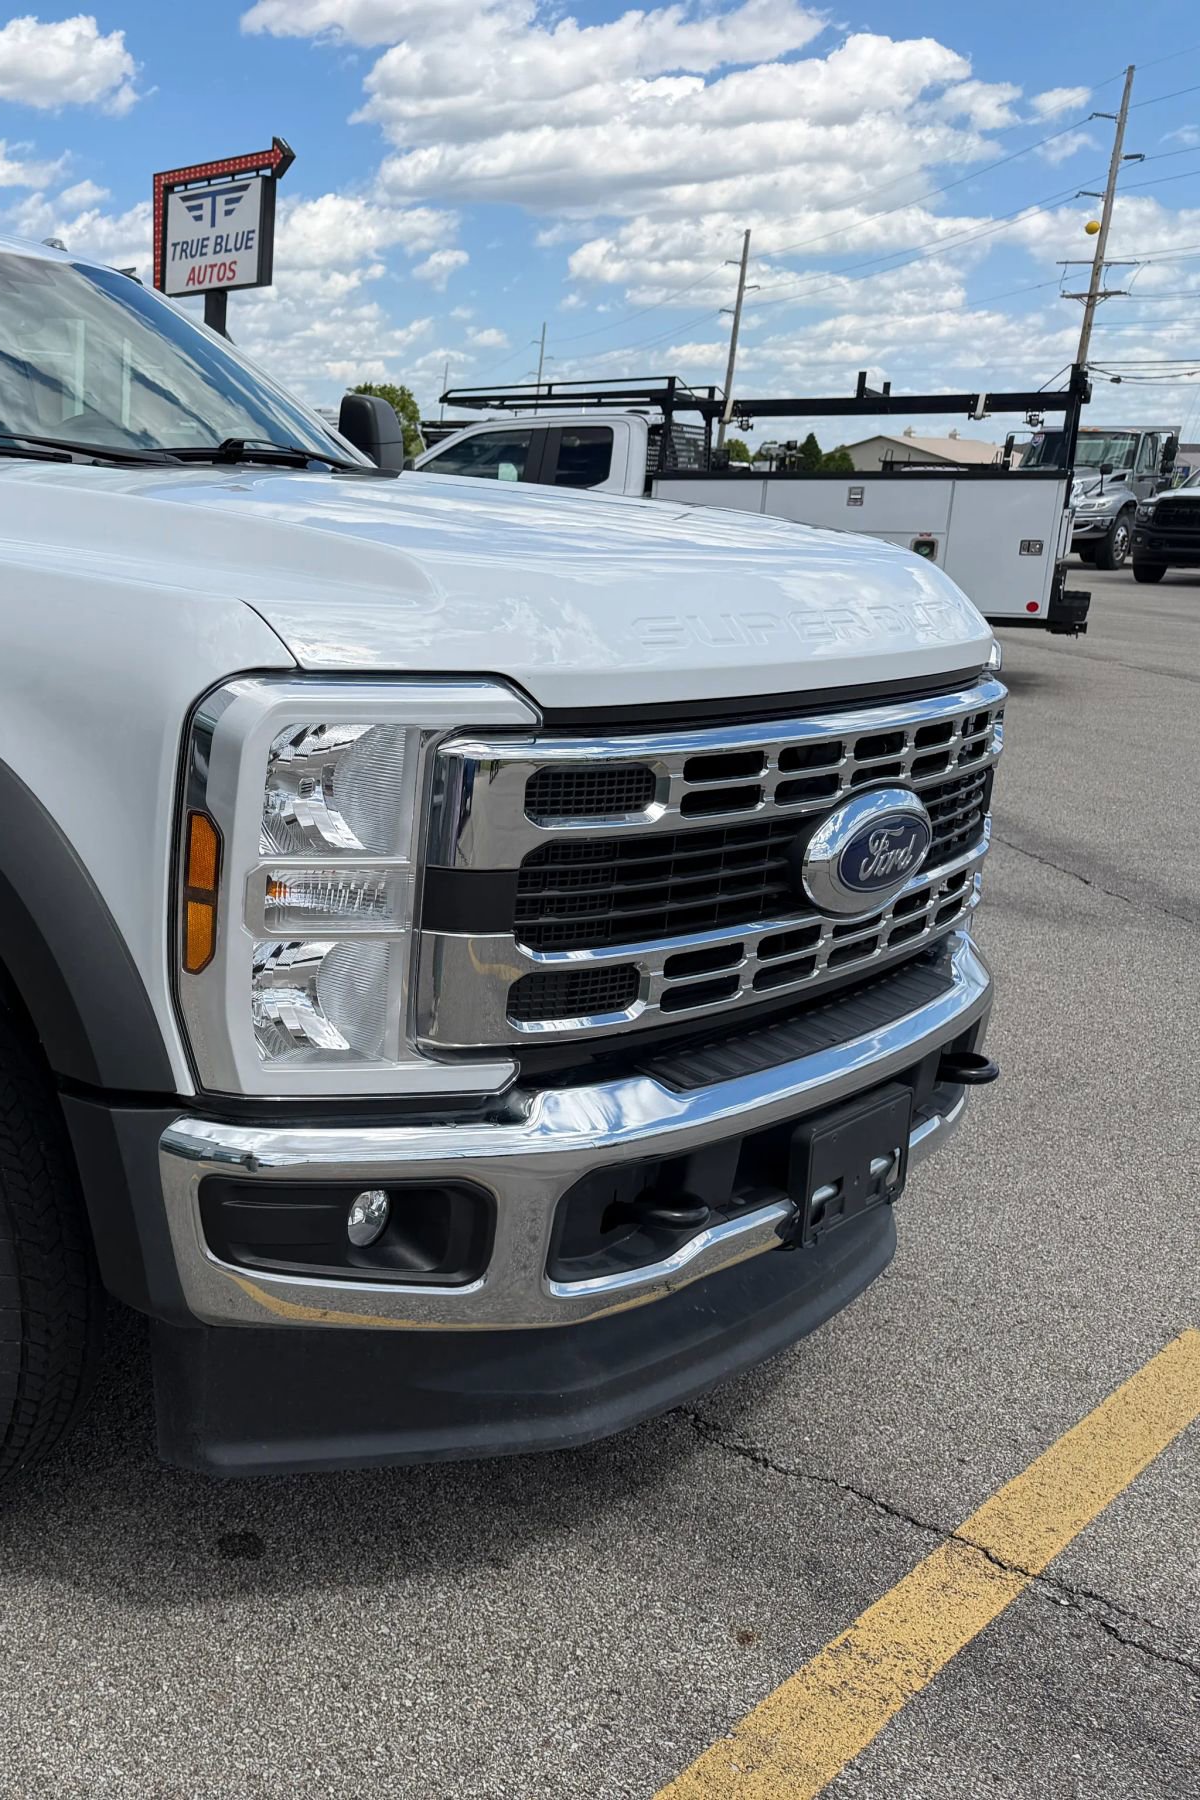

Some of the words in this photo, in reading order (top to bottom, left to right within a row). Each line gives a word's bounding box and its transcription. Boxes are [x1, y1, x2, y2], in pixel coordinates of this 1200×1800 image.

[171, 236, 210, 262] TRUE
[212, 229, 256, 255] BLUE
[185, 260, 238, 287] AUTOS
[858, 825, 918, 882] Ford
